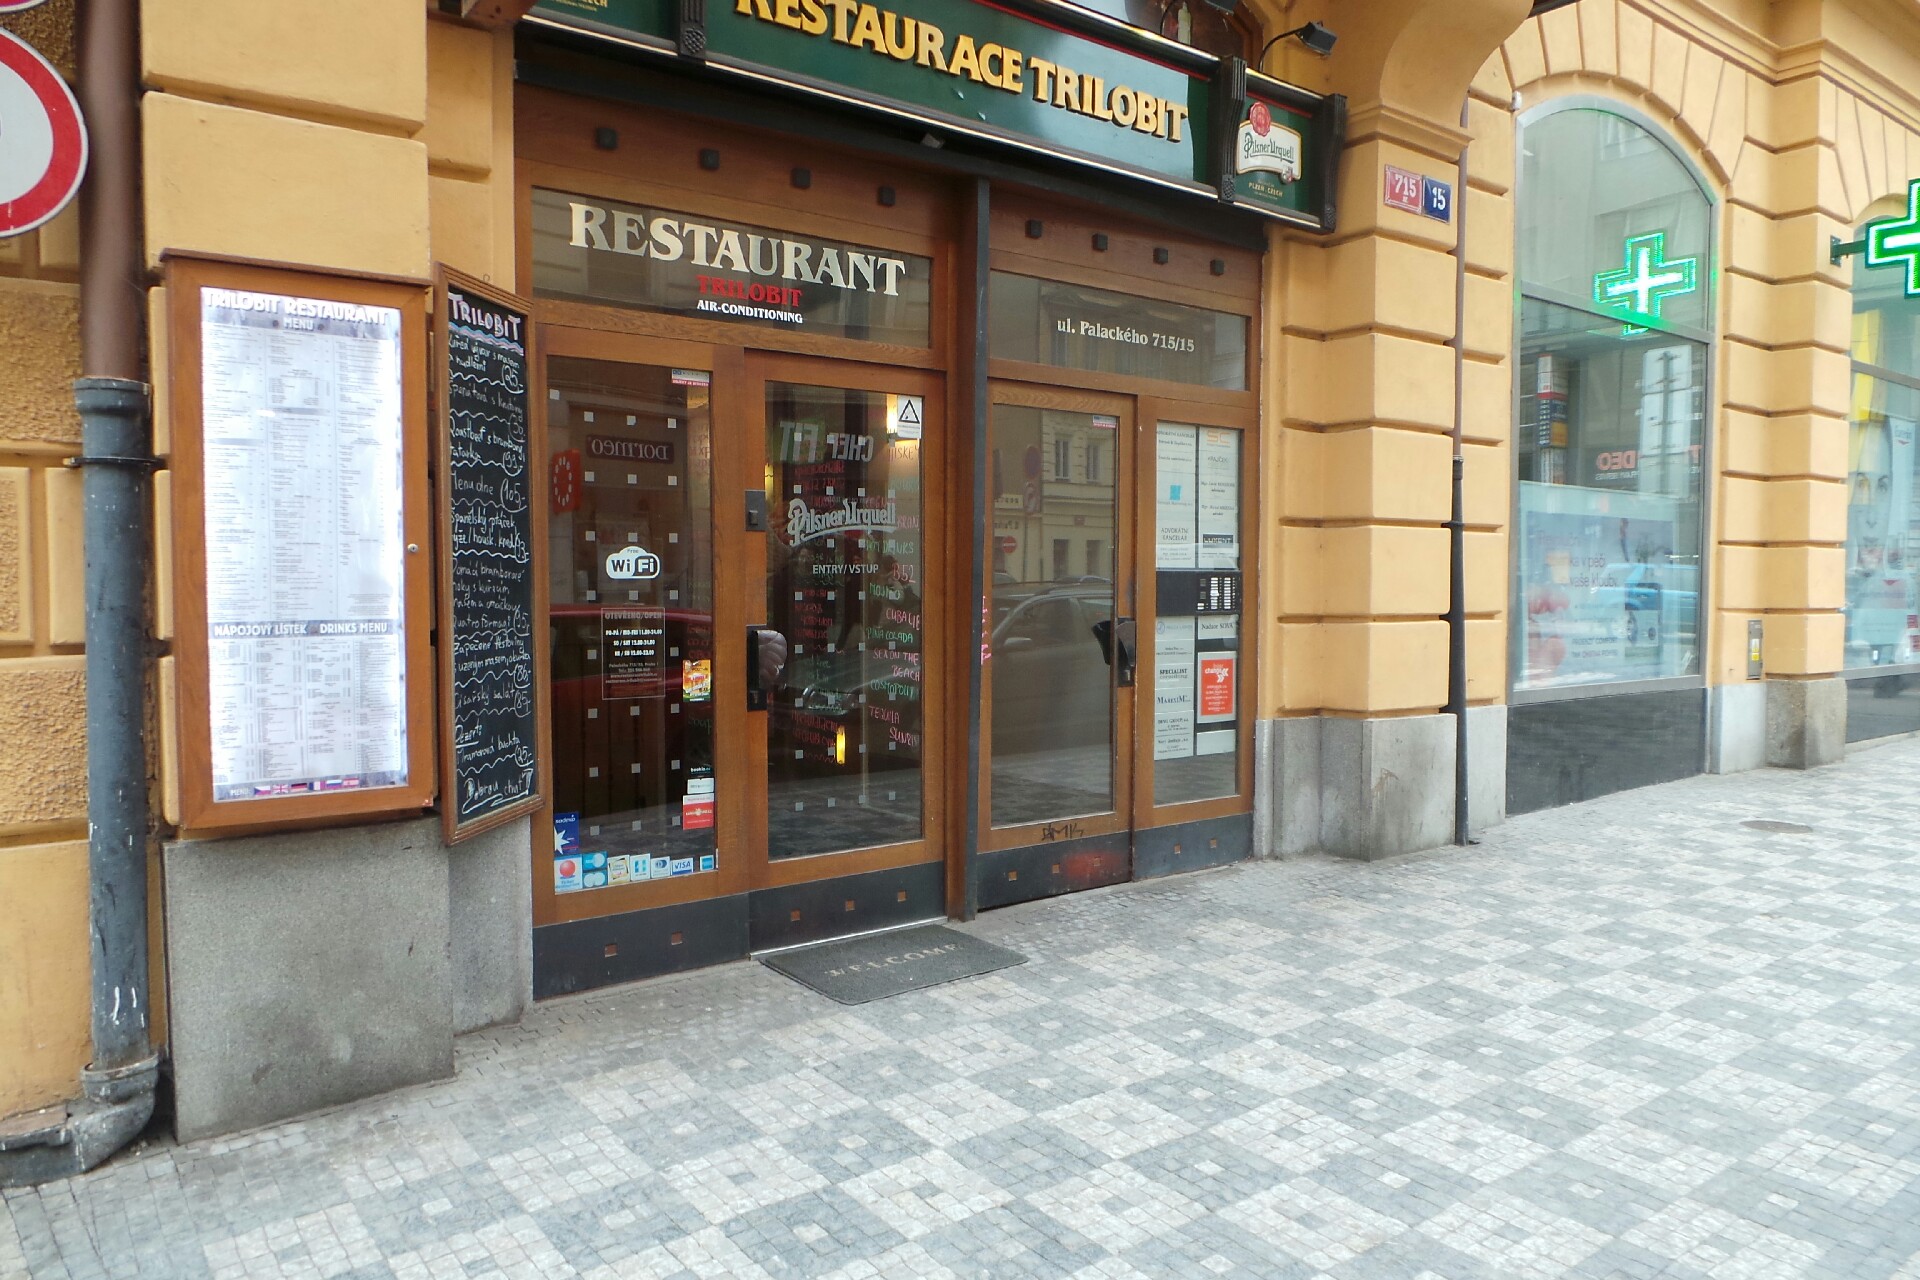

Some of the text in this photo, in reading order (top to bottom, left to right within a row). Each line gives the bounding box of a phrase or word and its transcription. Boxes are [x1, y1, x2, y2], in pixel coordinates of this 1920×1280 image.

[1027, 56, 1189, 143] TRILOBIT
[1243, 132, 1295, 164] Pilsner Urquell
[1394, 174, 1416, 199] 715
[1431, 187, 1447, 211] 15
[568, 202, 906, 297] RESTAURANT
[697, 275, 803, 308] TRILOBIT
[208, 292, 389, 325] TRILOBIT RESTAURANT
[447, 291, 521, 341] TRILOBIT
[697, 299, 804, 324] AIR-CONDITIONING
[283, 317, 315, 331] MENU
[1057, 318, 1195, 353] ul. Palackého 715/15
[787, 498, 896, 548] Pilsner Urquell
[319, 622, 357, 635] DRINKS
[359, 621, 388, 634] MENU
[885, 629, 914, 643] COLADA
[903, 651, 919, 666] THE
[891, 665, 920, 683] BEACH
[674, 860, 691, 870] VISA
[823, 943, 957, 977] WELCOME
